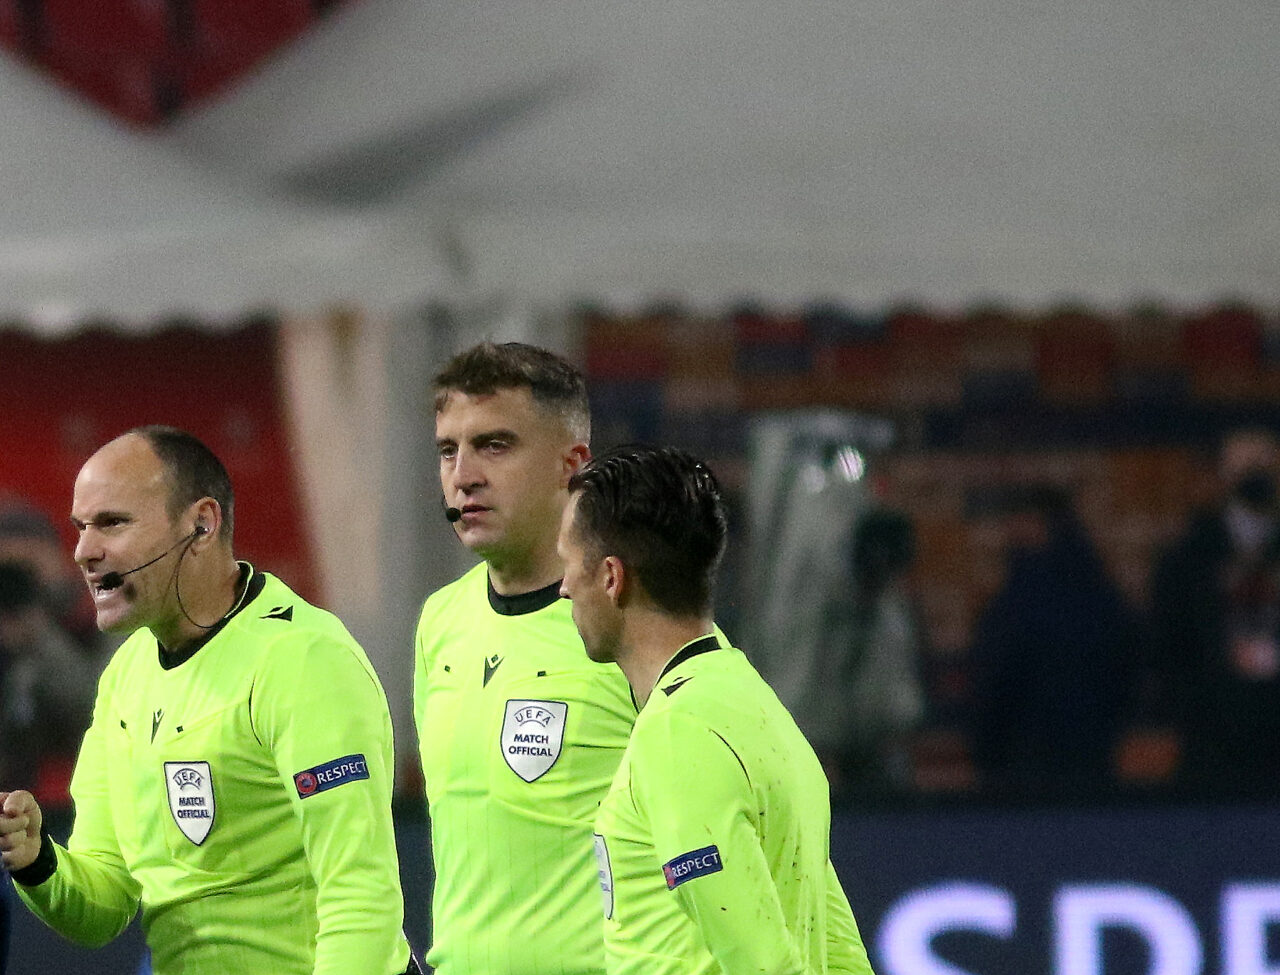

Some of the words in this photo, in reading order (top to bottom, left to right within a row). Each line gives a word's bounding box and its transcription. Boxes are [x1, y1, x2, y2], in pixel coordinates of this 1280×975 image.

[515, 709, 551, 725] UEFA
[513, 734, 549, 744] MATCH
[508, 745, 553, 757] OFFICIAL
[174, 771, 202, 786] UEFA
[317, 761, 366, 784] RESPECT
[178, 796, 206, 807] MATCH
[176, 809, 210, 819] OFFICIAL
[671, 852, 719, 878] RESPECT
